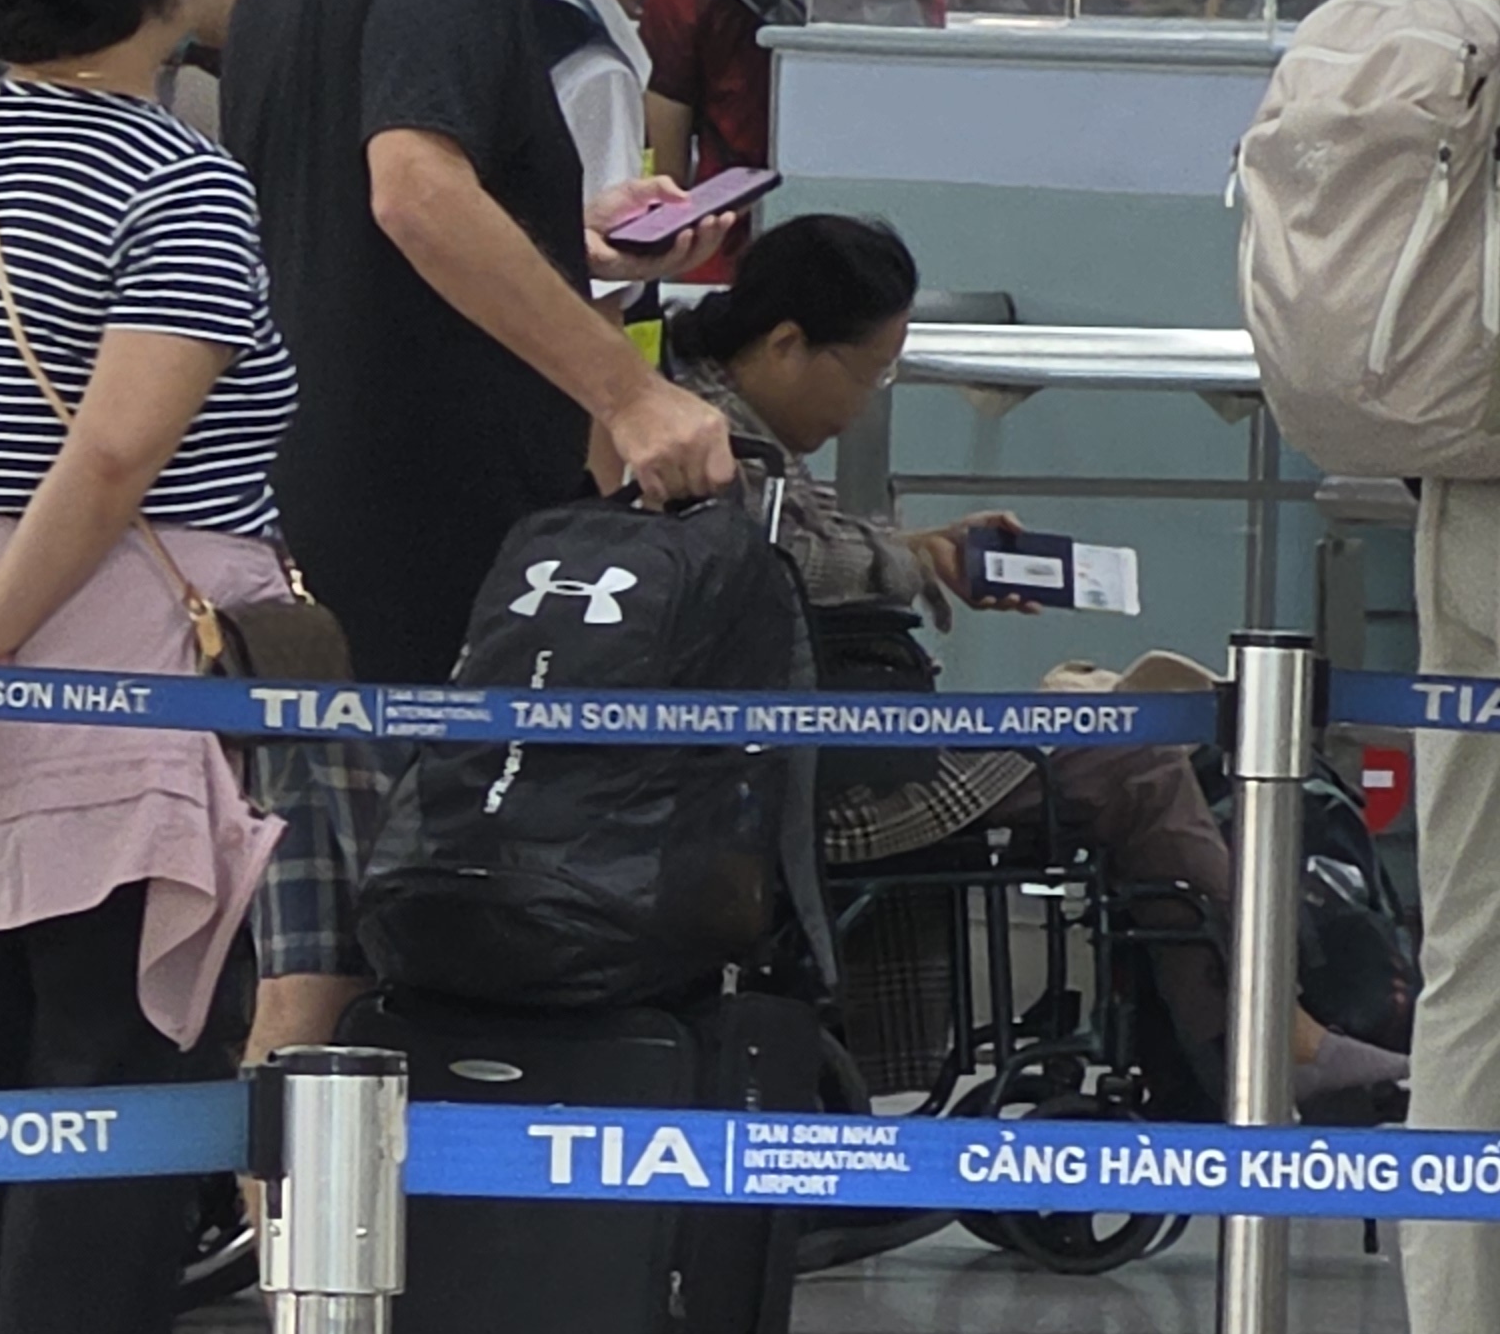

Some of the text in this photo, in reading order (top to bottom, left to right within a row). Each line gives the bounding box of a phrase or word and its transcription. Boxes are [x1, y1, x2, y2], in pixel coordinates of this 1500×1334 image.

[62, 677, 151, 715] NHẤT
[249, 687, 375, 732] TIA
[510, 701, 1140, 734] TAN SON NHAT INTERNATIONAL AIRPORT
[747, 1123, 900, 1147] TAN SON NHAT
[528, 1124, 710, 1188] TIA
[743, 1149, 911, 1173] INTERNATIONAL
[959, 1131, 1088, 1185] CẢNG
[1100, 1134, 1228, 1187] HÀNG
[1239, 1140, 1399, 1193] KHÔNG
[744, 1173, 839, 1197] AIRPORT
